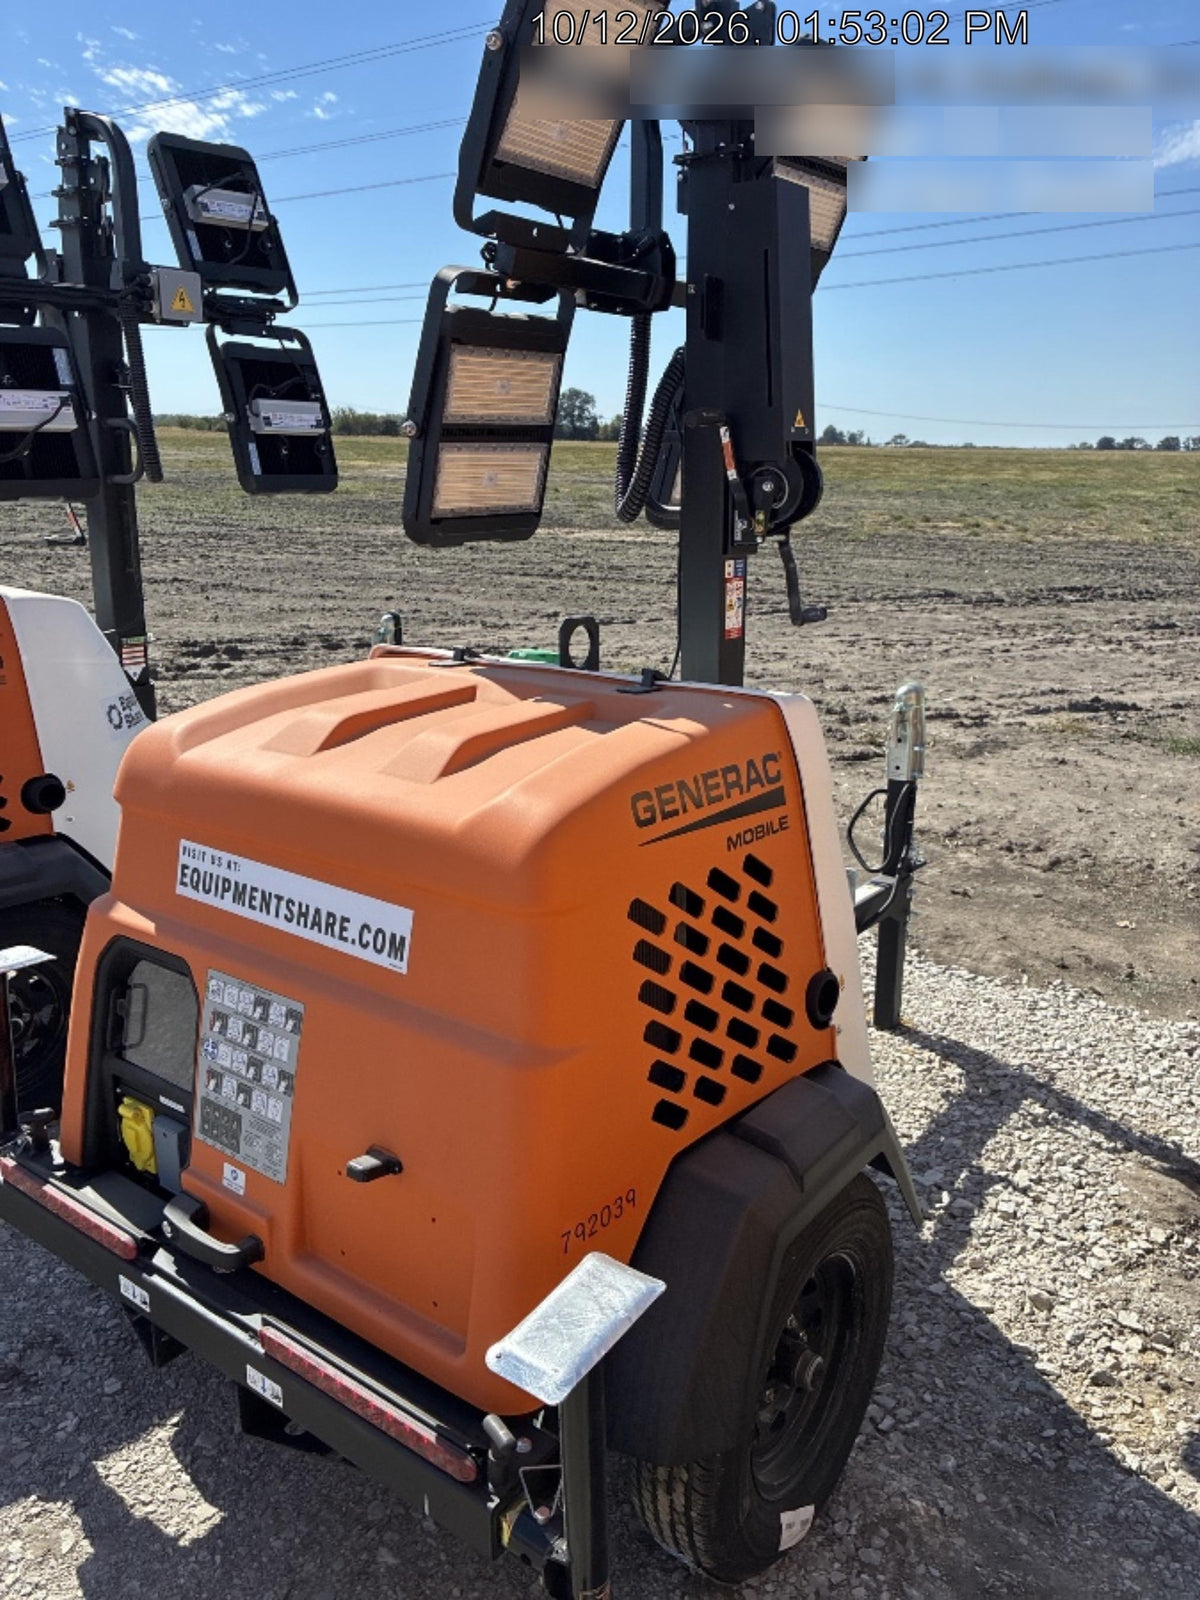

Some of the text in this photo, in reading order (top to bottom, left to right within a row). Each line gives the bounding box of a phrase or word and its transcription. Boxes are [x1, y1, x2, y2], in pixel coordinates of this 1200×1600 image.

[631, 753, 781, 828] GENERAC
[182, 845, 206, 863] VISIT
[727, 816, 789, 851] MOBILE
[179, 864, 407, 962] EQUIPMENTSHARE.COM
[561, 1189, 636, 1254] 792039
